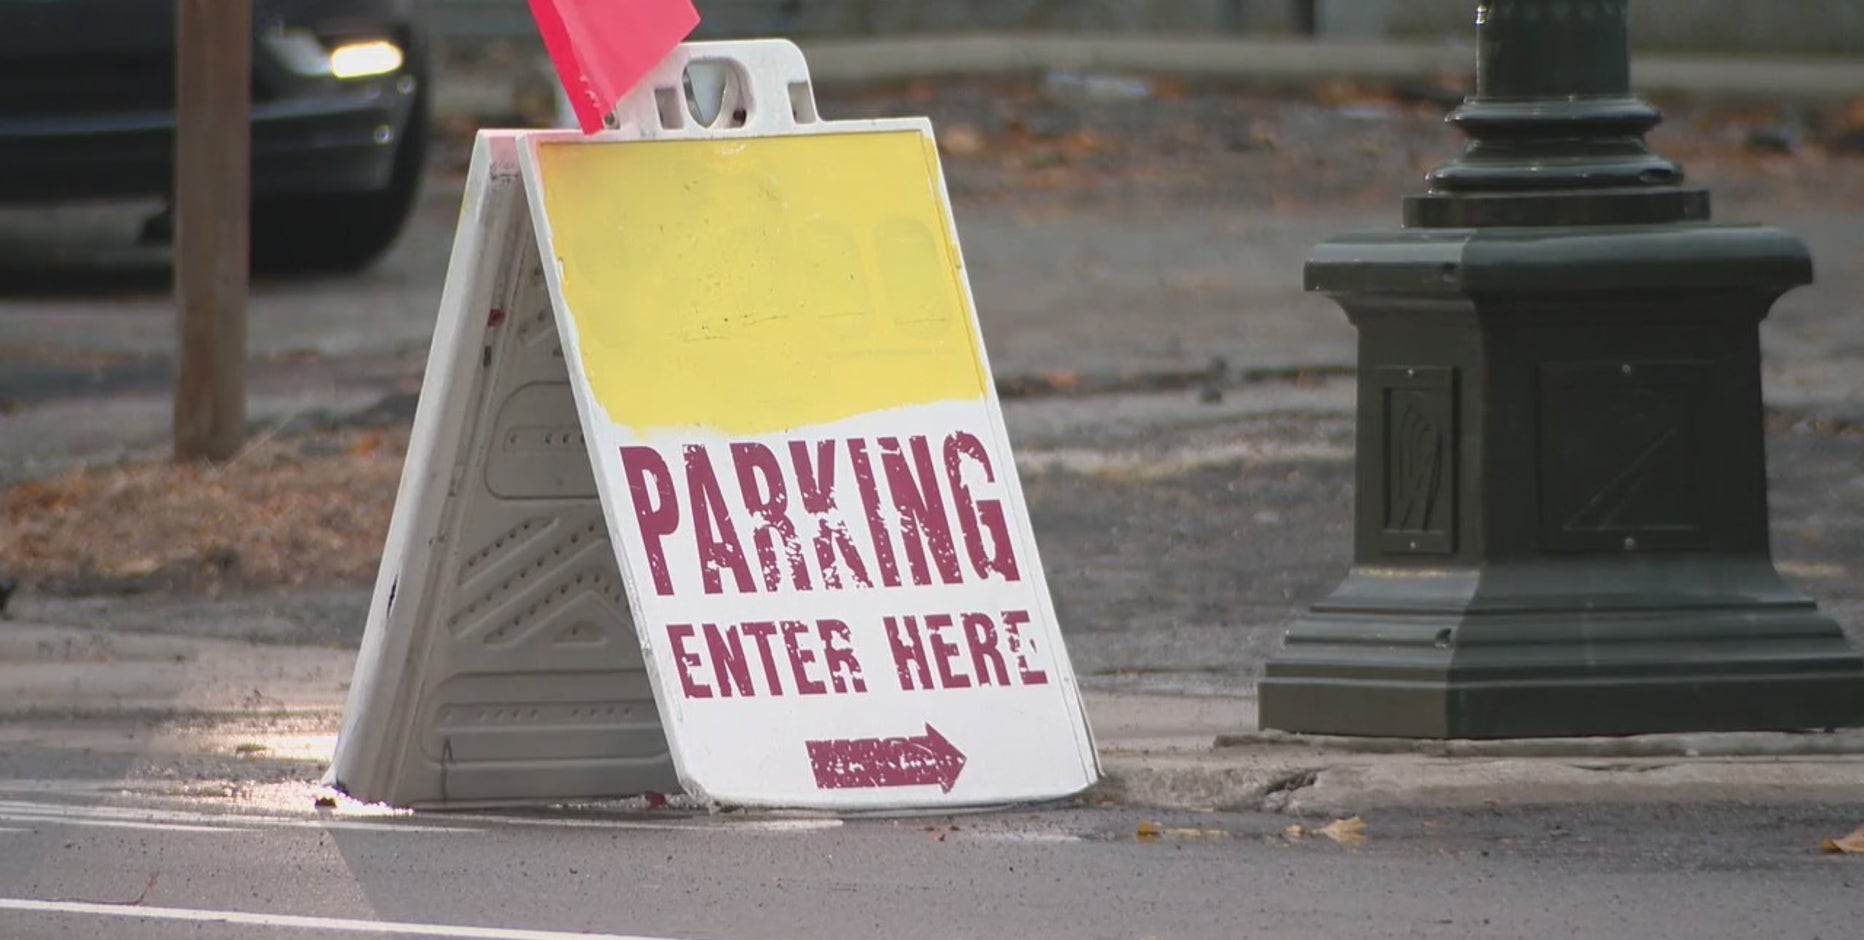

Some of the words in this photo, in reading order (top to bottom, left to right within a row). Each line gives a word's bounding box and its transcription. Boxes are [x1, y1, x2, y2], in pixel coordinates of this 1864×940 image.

[620, 431, 1021, 596] PARKING
[666, 620, 868, 699] ENTER
[883, 610, 1049, 691] HERE
